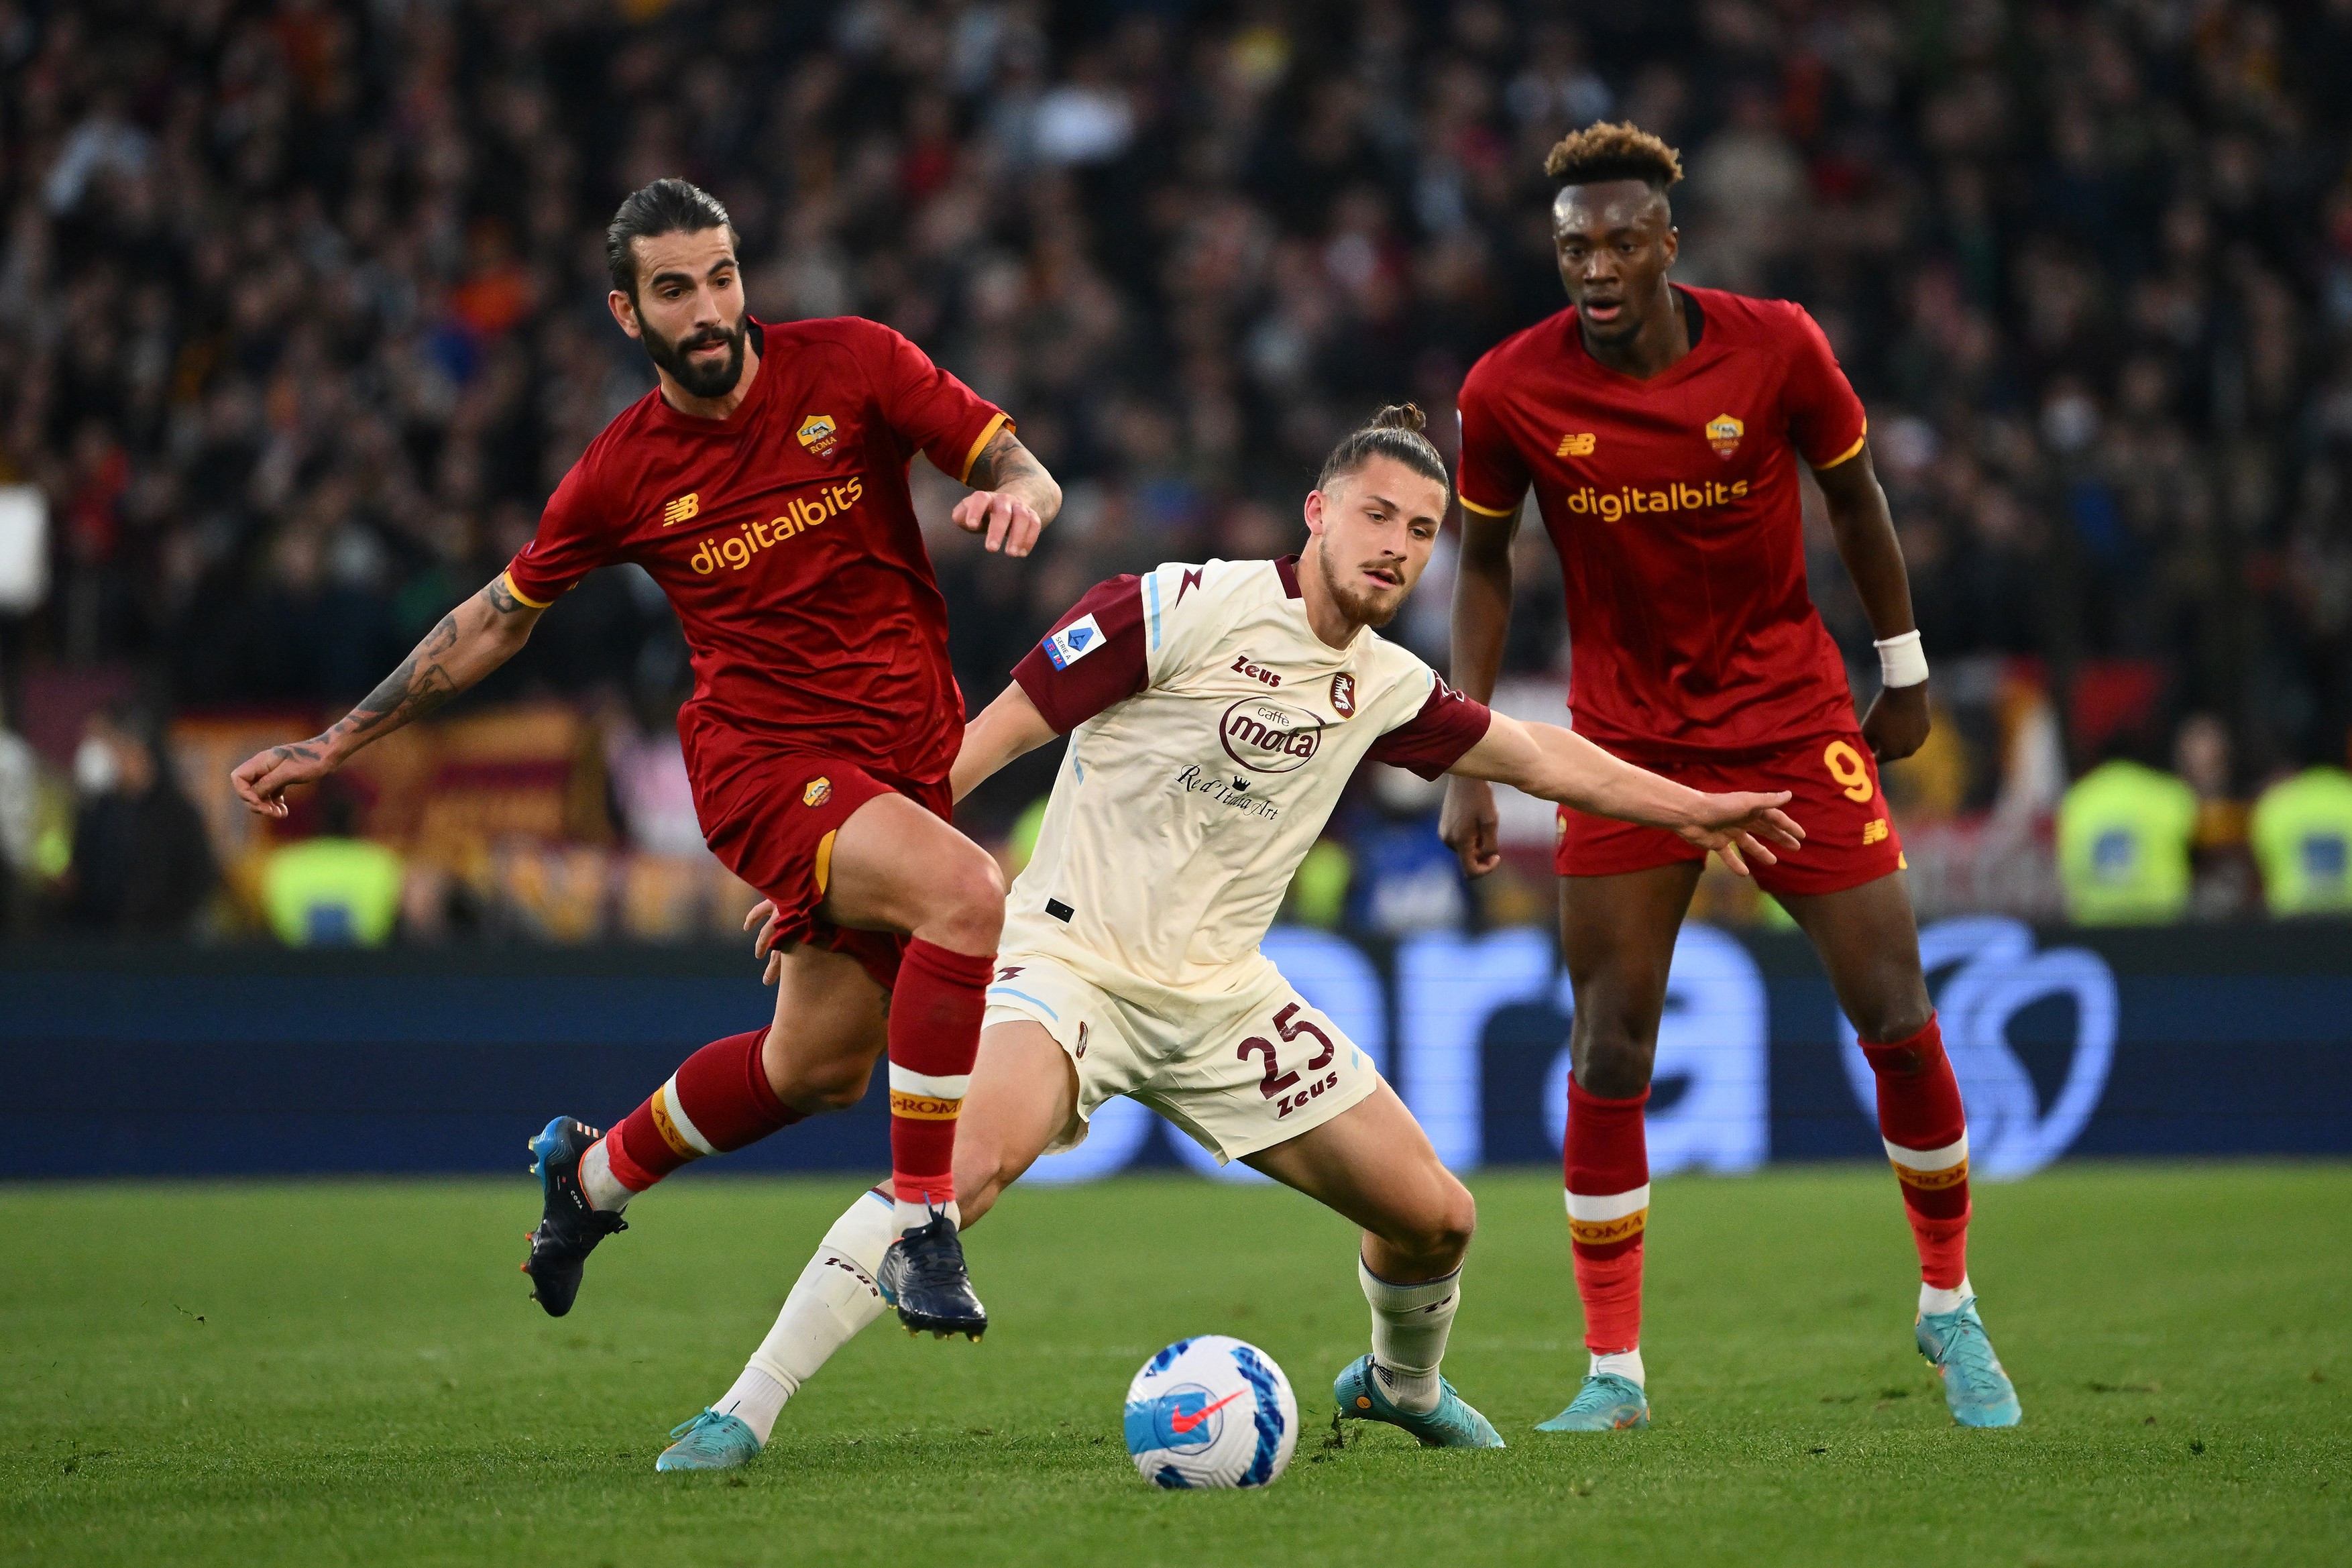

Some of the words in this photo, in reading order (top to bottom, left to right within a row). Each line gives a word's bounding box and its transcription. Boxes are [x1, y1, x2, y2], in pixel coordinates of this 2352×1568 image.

[809, 436, 838, 454] ROMA
[1567, 480, 1748, 522] digitalbits
[691, 477, 862, 575] digitalbits
[1055, 636, 1069, 655] SERIE
[1334, 700, 1349, 710] 1919
[1257, 706, 1290, 728] caffè
[1824, 740, 1874, 803] 9
[1243, 799, 1278, 820] Art
[1237, 1001, 1335, 1101] 25
[901, 1098, 962, 1114] ROM
